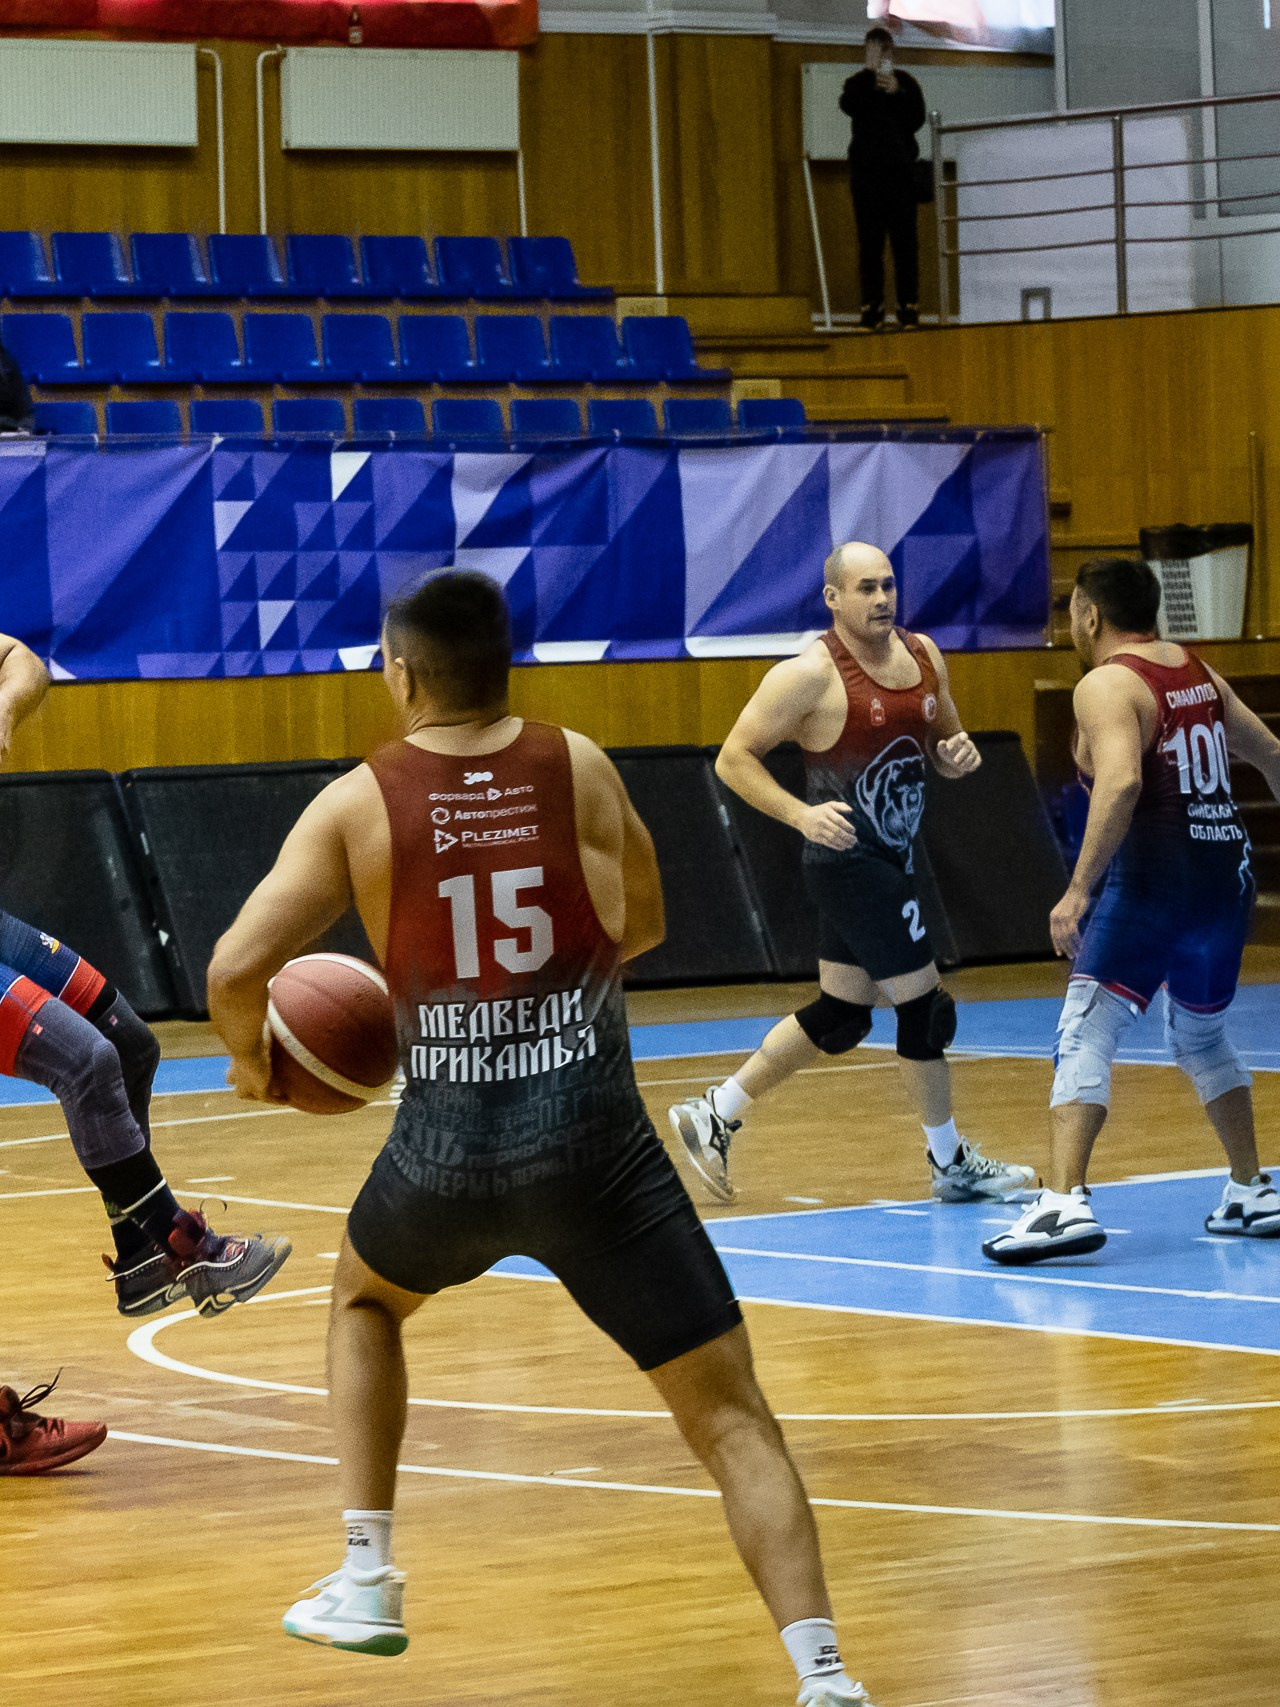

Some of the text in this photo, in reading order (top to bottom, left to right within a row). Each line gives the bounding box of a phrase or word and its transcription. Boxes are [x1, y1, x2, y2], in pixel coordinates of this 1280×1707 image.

[1166, 682, 1218, 709] СМАИЛОВ
[1163, 720, 1231, 795] 100
[454, 804, 538, 820] Автопрестиж
[1187, 802, 1233, 819] ОМСКАЯ
[461, 825, 539, 842] PLEZIMET
[1189, 824, 1243, 841] ОБЛАСТЬ
[438, 866, 554, 979] 15
[902, 899, 926, 943] 2
[418, 988, 583, 1043] МЕДВЕДИ
[411, 1025, 596, 1083] ПРИКАМЬЯ
